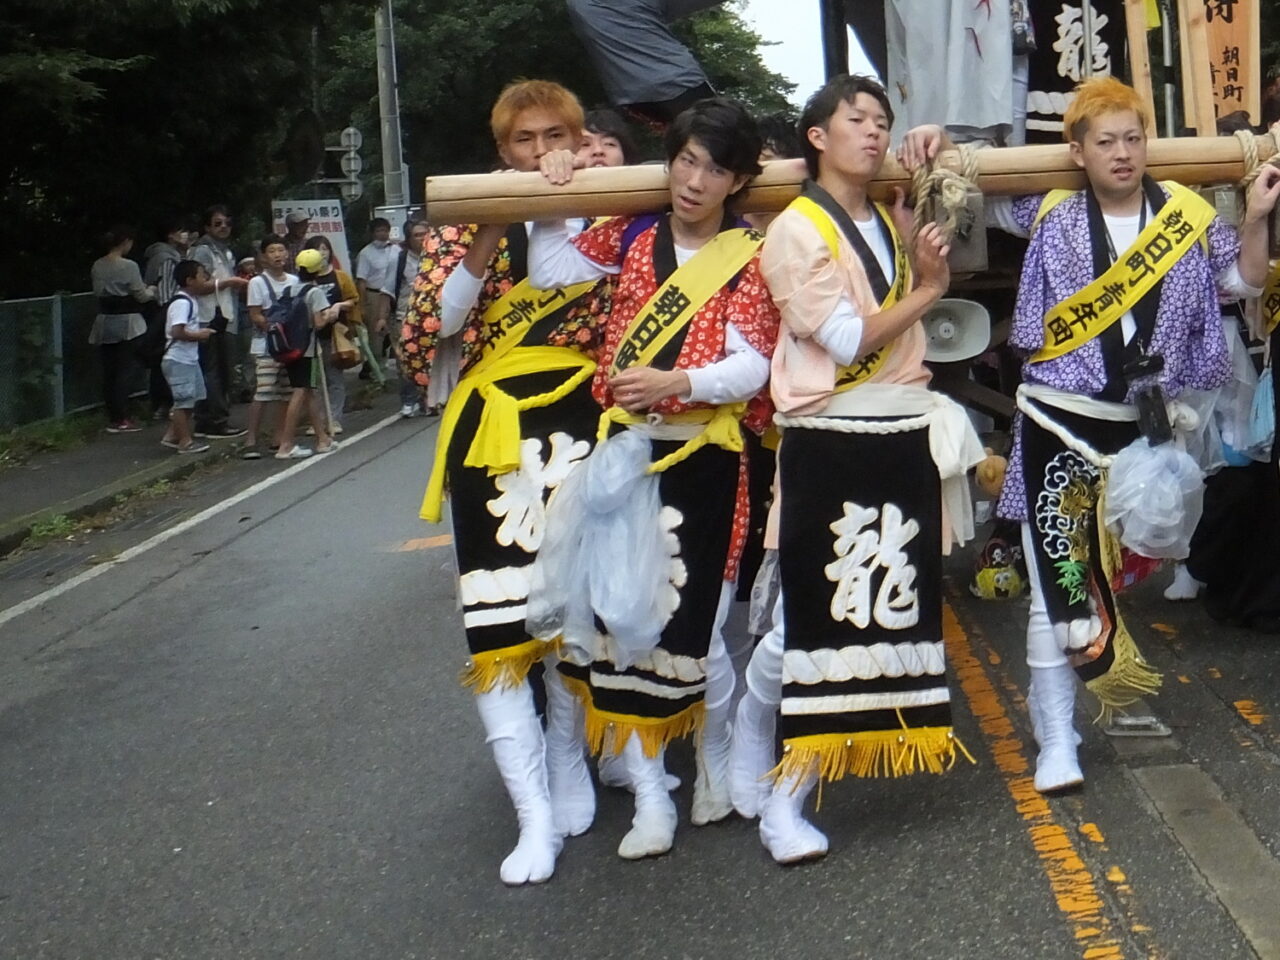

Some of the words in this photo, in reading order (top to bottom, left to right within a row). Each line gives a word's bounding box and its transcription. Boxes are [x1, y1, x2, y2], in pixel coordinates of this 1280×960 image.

[1052, 3, 1111, 82] 龍
[1221, 45, 1244, 103] 朝日町
[274, 206, 340, 219] ほい祭り
[1047, 208, 1195, 347] 朝日町青年団
[824, 501, 920, 630] 龍
